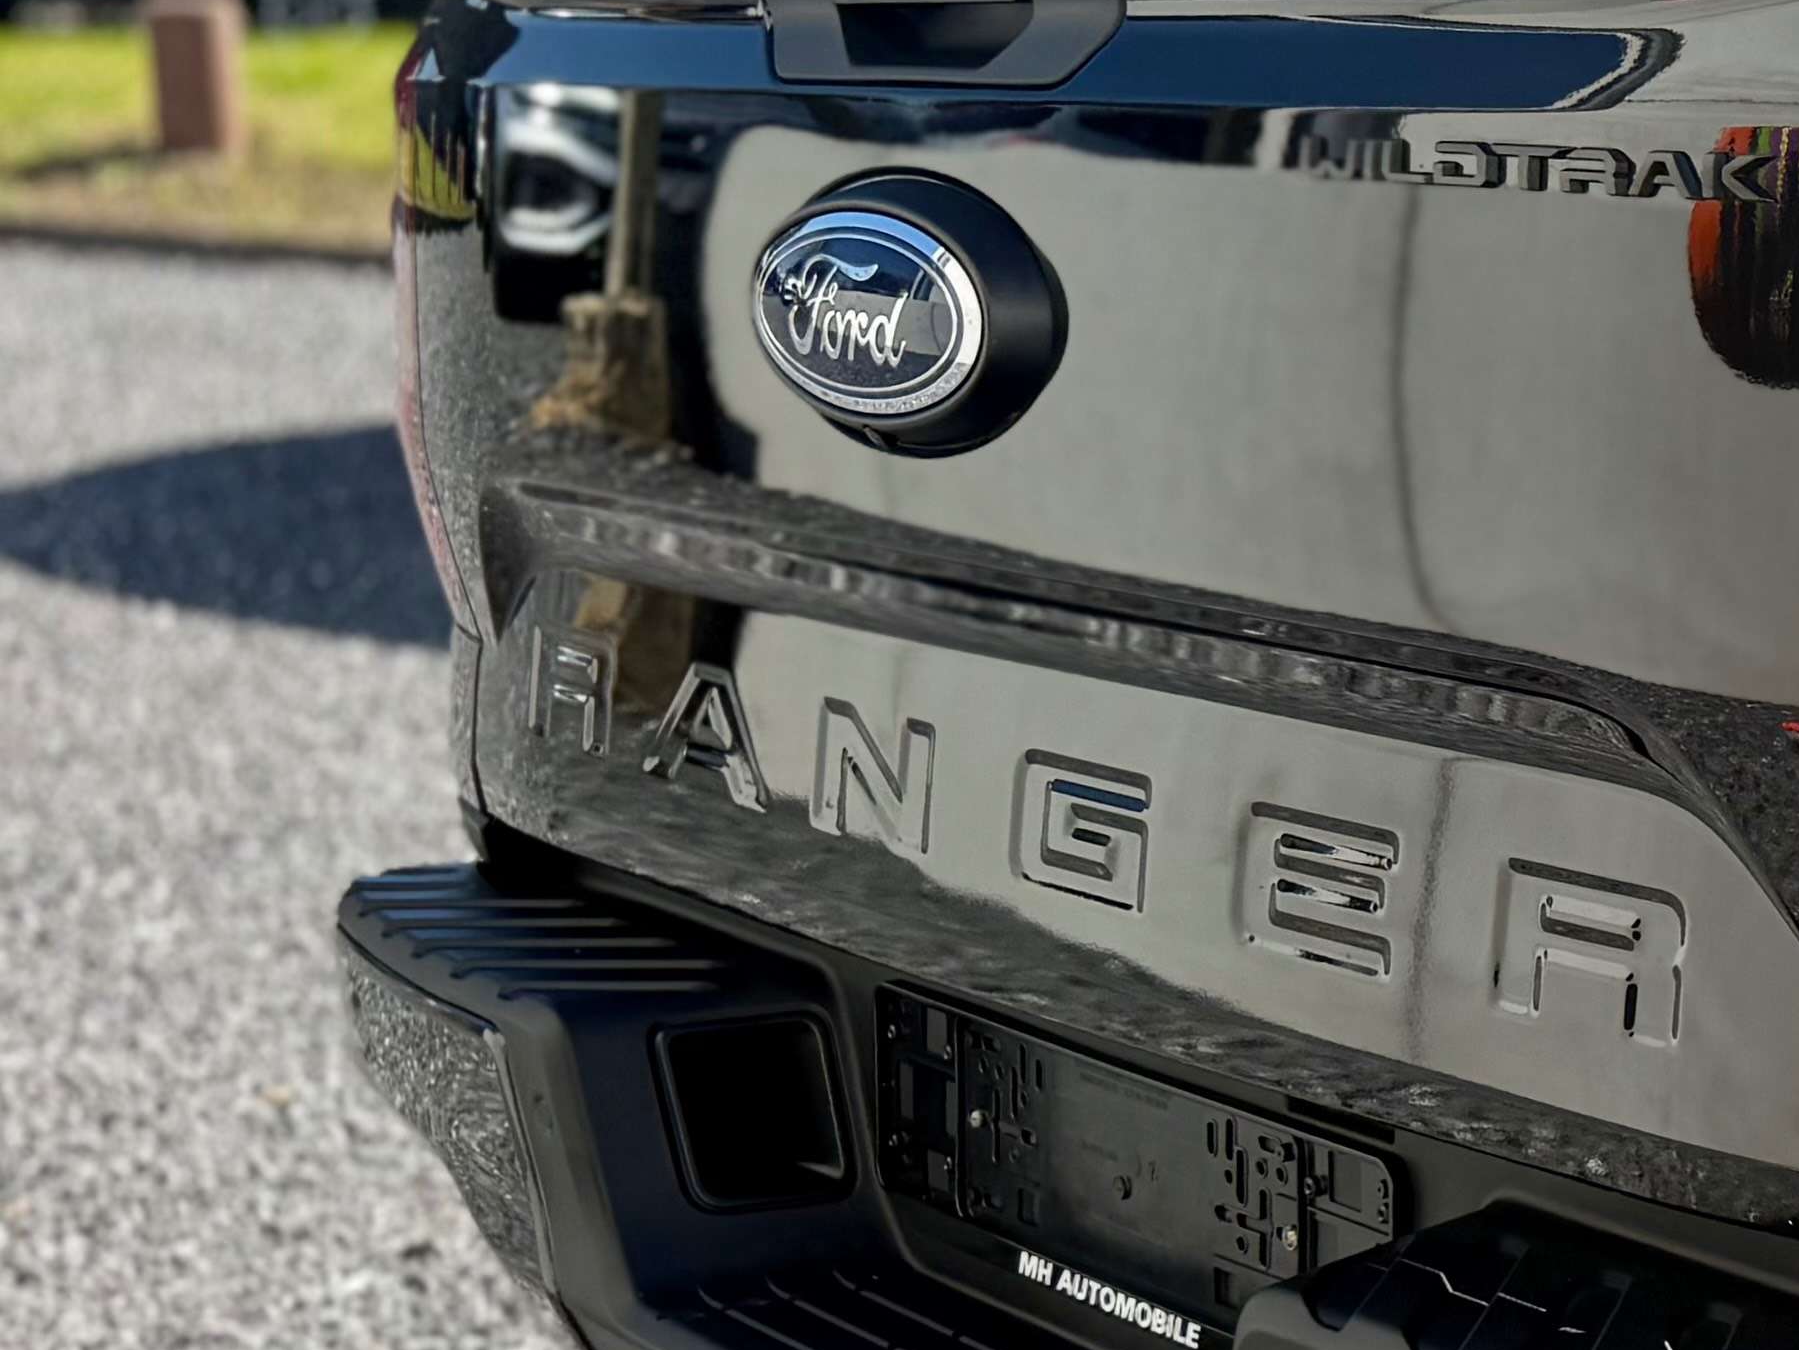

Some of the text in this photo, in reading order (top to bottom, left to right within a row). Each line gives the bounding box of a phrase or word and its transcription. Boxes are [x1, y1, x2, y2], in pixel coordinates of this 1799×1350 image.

[1299, 135, 1779, 203] WILDTRAK
[784, 252, 908, 369] Ford
[527, 624, 1690, 1051] RANGER
[1018, 1250, 1202, 1350] MH AUTOMOBILE
